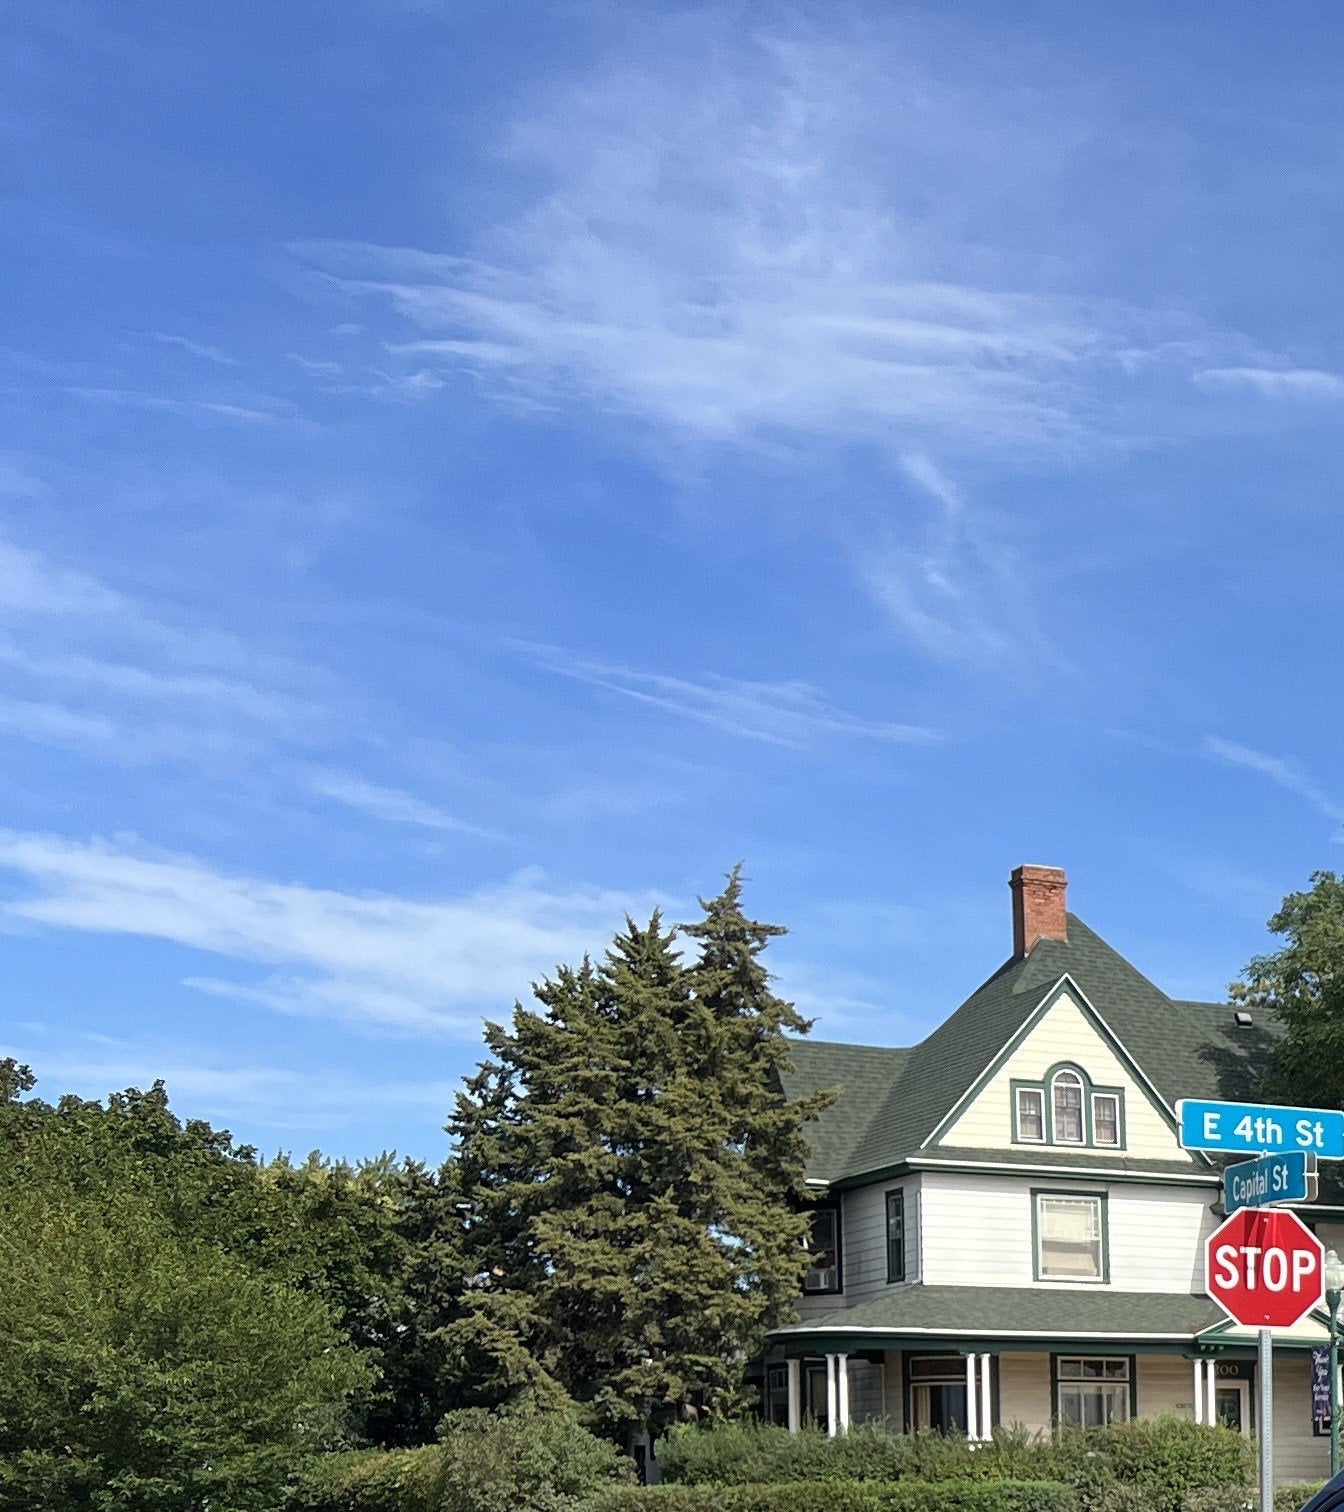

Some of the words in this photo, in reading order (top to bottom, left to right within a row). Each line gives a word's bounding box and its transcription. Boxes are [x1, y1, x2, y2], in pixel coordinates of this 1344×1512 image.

[1203, 1112, 1222, 1140] E
[1233, 1115, 1283, 1144] 4th
[1295, 1119, 1325, 1147] St
[1232, 1168, 1268, 1202] Capital
[1272, 1164, 1289, 1191] St
[1214, 1244, 1316, 1292] STOP
